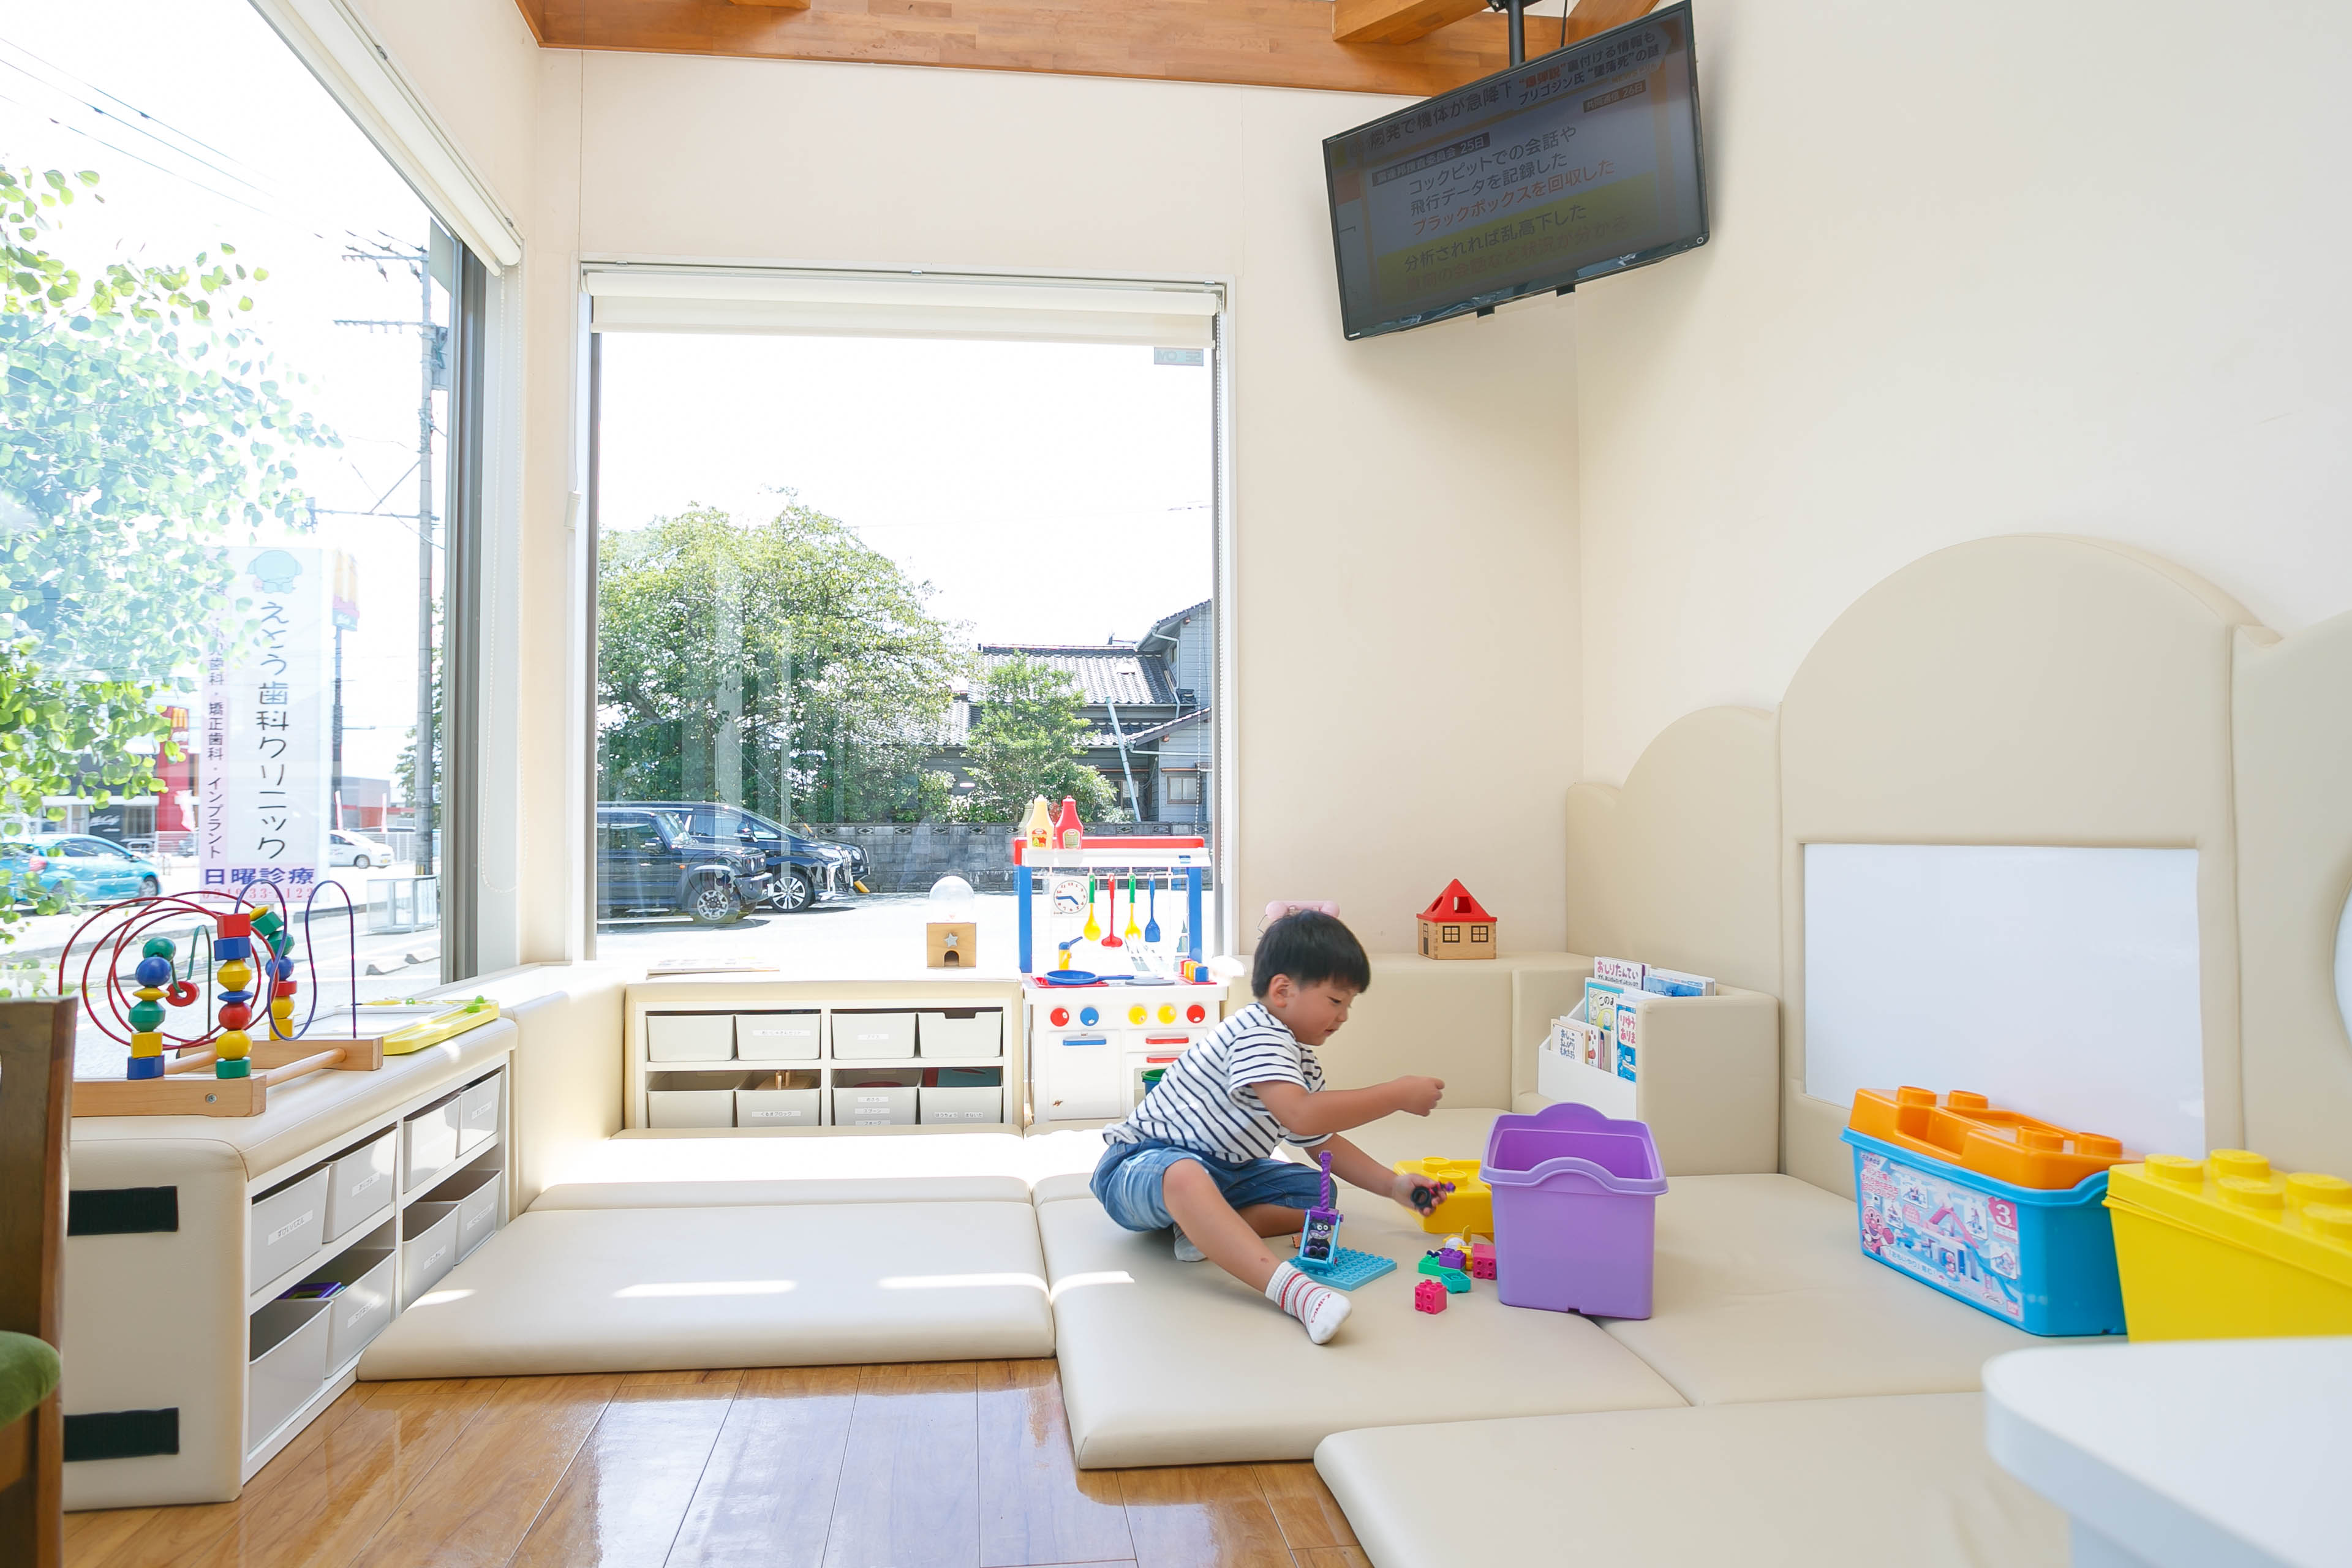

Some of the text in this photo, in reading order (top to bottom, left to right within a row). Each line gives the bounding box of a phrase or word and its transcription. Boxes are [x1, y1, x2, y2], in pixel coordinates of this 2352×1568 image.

[1409, 126, 1577, 195] コックピットでの会話や
[1460, 137, 1484, 154] 25日
[1411, 151, 1568, 217] 飛行データを記録した
[1412, 159, 1616, 236] ブラックボックスを回収した
[1404, 204, 1588, 273] 分析されれば乱高下した
[256, 601, 290, 859] えとう歯科クリニック
[205, 867, 314, 884] 日曜診療
[1597, 960, 1639, 979] おしりたんてい
[1620, 1015, 1635, 1030] りゆう
